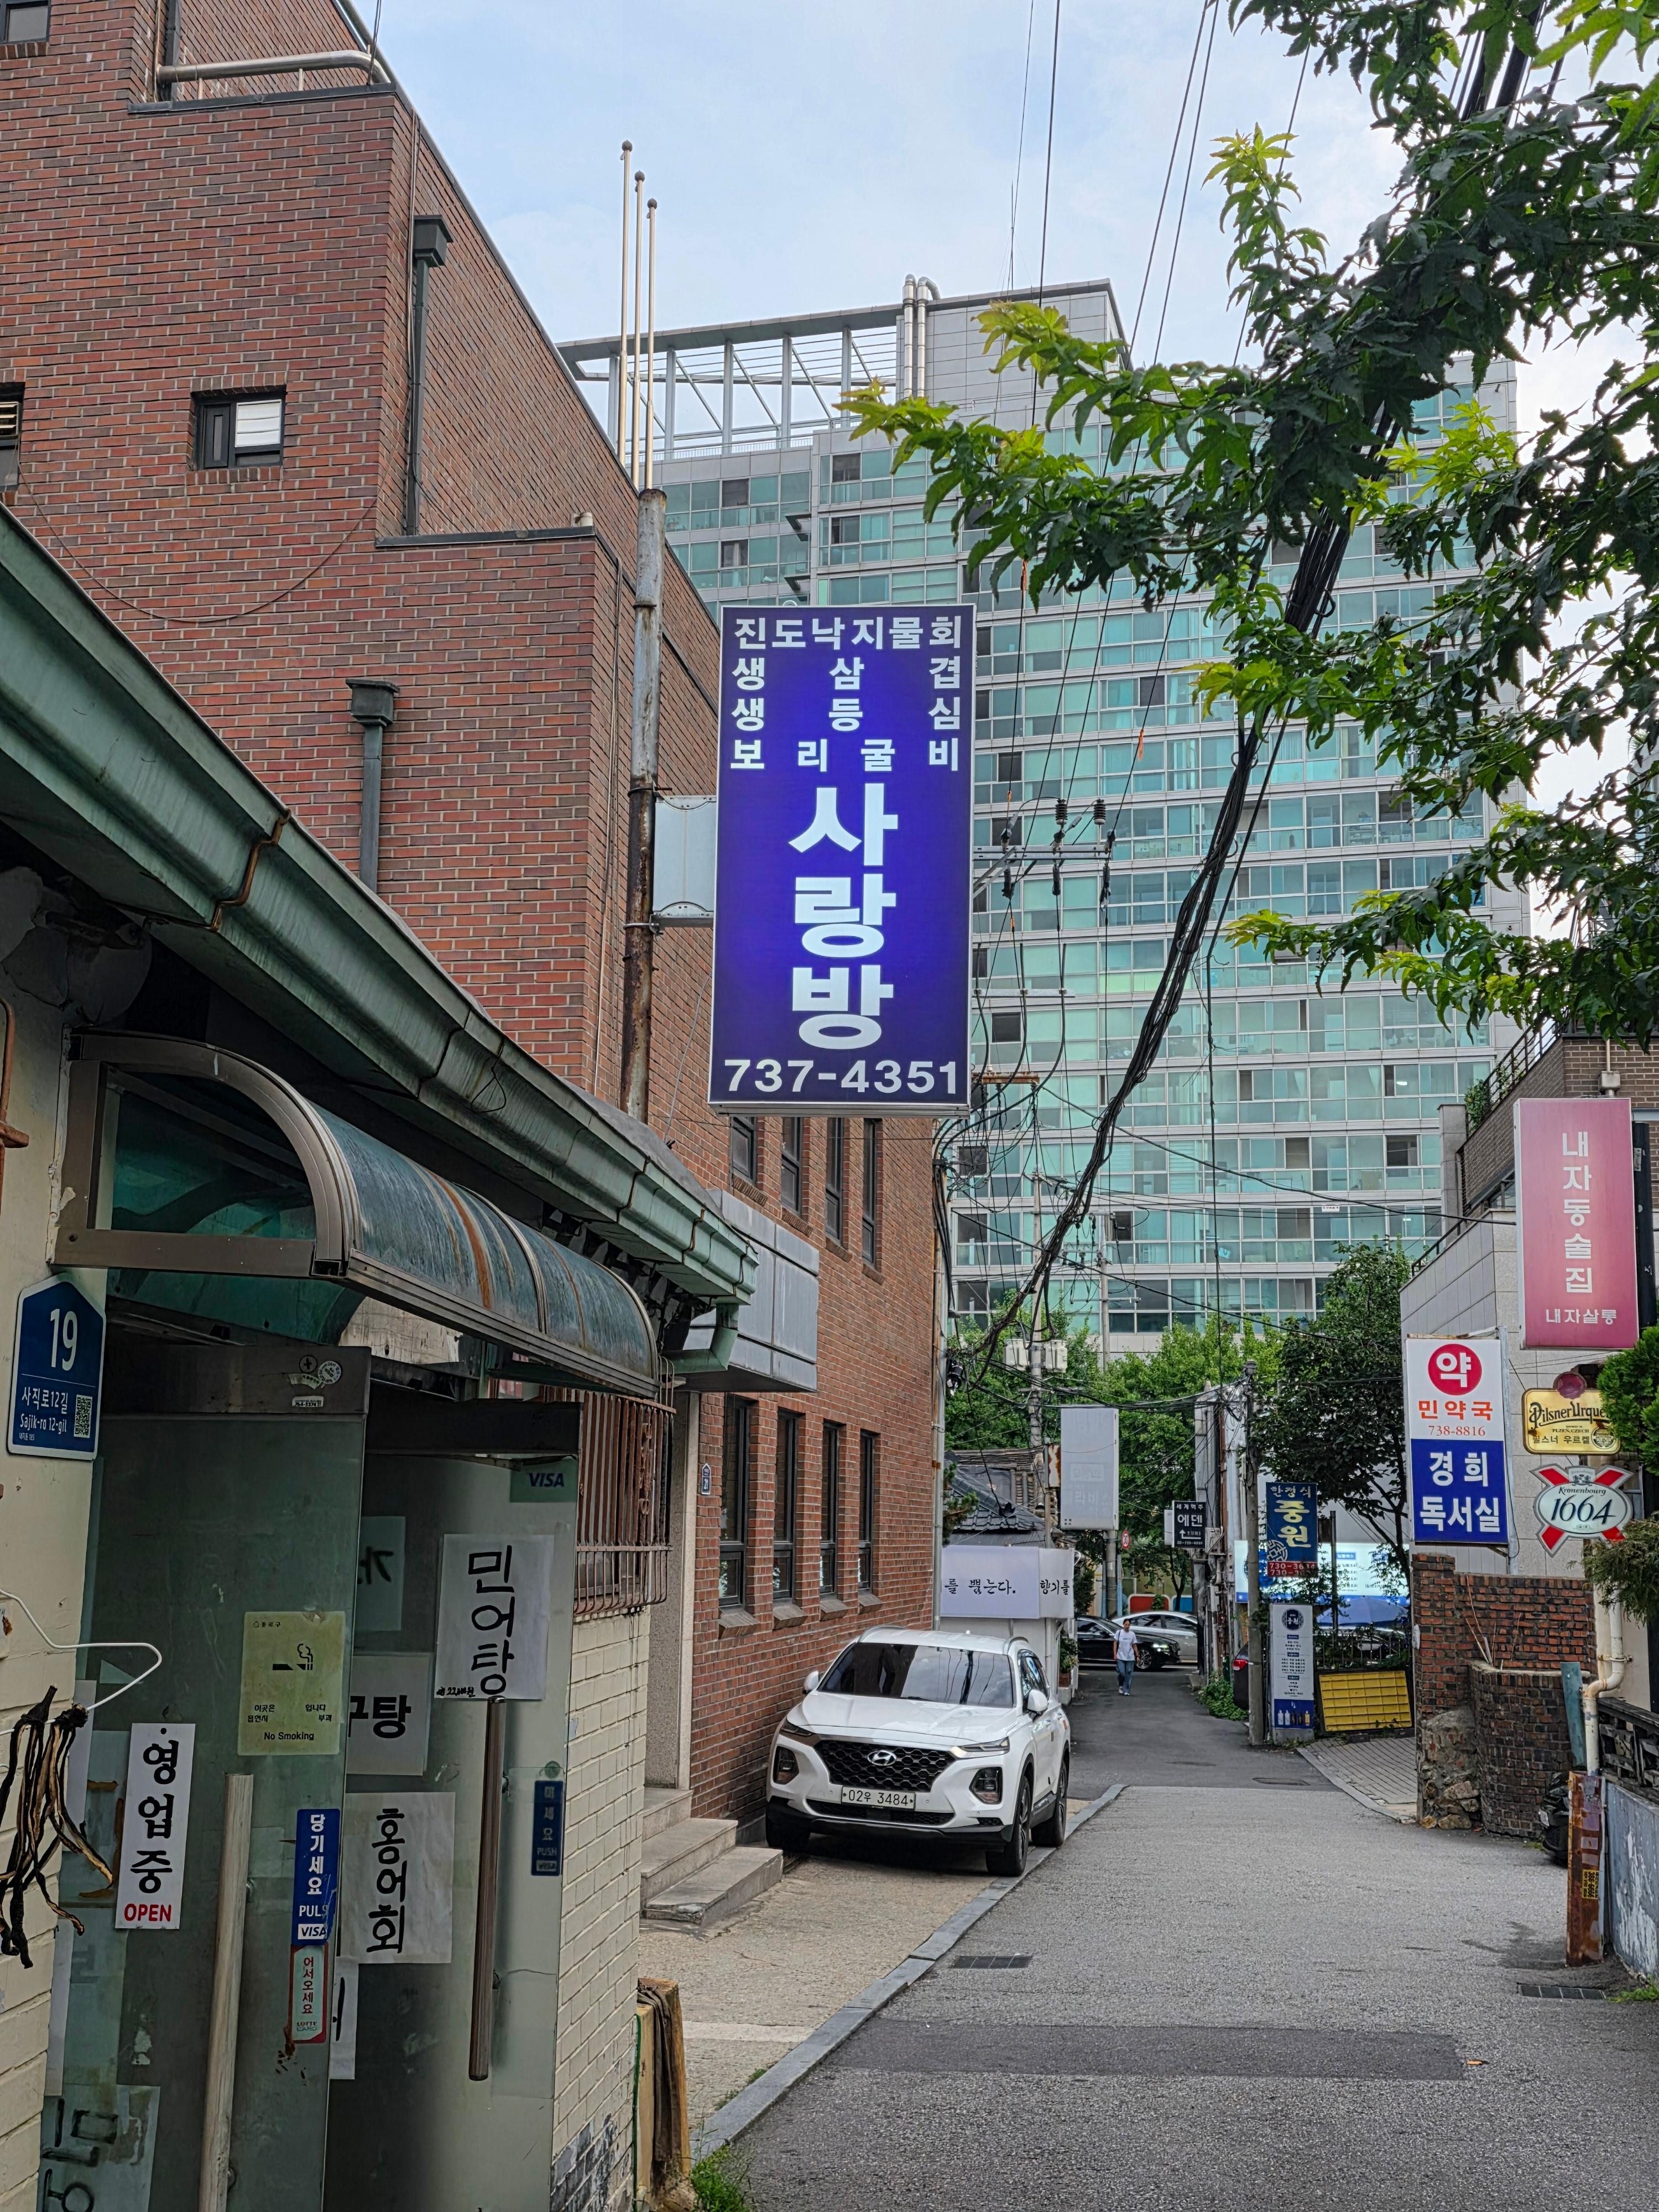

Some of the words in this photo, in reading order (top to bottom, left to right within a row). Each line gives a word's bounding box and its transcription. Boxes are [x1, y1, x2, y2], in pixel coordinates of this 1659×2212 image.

[734, 615, 962, 650] 진도낙지물회
[731, 739, 958, 772] 보리굴비
[788, 783, 898, 1050] 사랑방
[724, 1058, 956, 1094] 737-4351
[1562, 1131, 1593, 1293] 내자동술집
[1546, 1308, 1617, 1326] 내자살롱
[50, 1308, 78, 1371] 19
[1437, 1353, 1472, 1387] 약
[22, 1386, 68, 1415] 사직로12길
[1418, 1400, 1493, 1421] 민약국
[20, 1413, 46, 1431] Sajik-ro
[49, 1417, 67, 1434] 12-gil
[1529, 1402, 1572, 1430] Pilsner
[1570, 1401, 1610, 1425] Urque
[1428, 1425, 1486, 1437] 738-8816
[1563, 1435, 1590, 1444] 우르켈
[528, 1472, 565, 1489] VISA
[1430, 1451, 1488, 1487] 경희
[1271, 1485, 1311, 1498] 한정식
[1558, 1486, 1606, 1496] Kronenbourg
[1177, 1514, 1203, 1527] 에덴
[1274, 1500, 1312, 1548] 중원
[1420, 1496, 1500, 1532] 독서실
[1551, 1494, 1616, 1525] 1664
[1039, 1579, 1071, 1595] 향기를
[468, 1545, 515, 1697] 민어탕
[305, 1704, 326, 1712] 입니다
[264, 1732, 275, 1740] No
[278, 1731, 315, 1741] Smoking
[849, 1790, 871, 1802] 02우
[877, 1792, 908, 1806] 3484
[131, 1740, 179, 1893] 영업중
[307, 1814, 326, 1895] 당기세요
[366, 1808, 408, 1954] 홍어회
[124, 1903, 172, 1922] OPEN
[301, 1926, 327, 1937] VISA
[301, 1956, 314, 2014] 어서오세요
